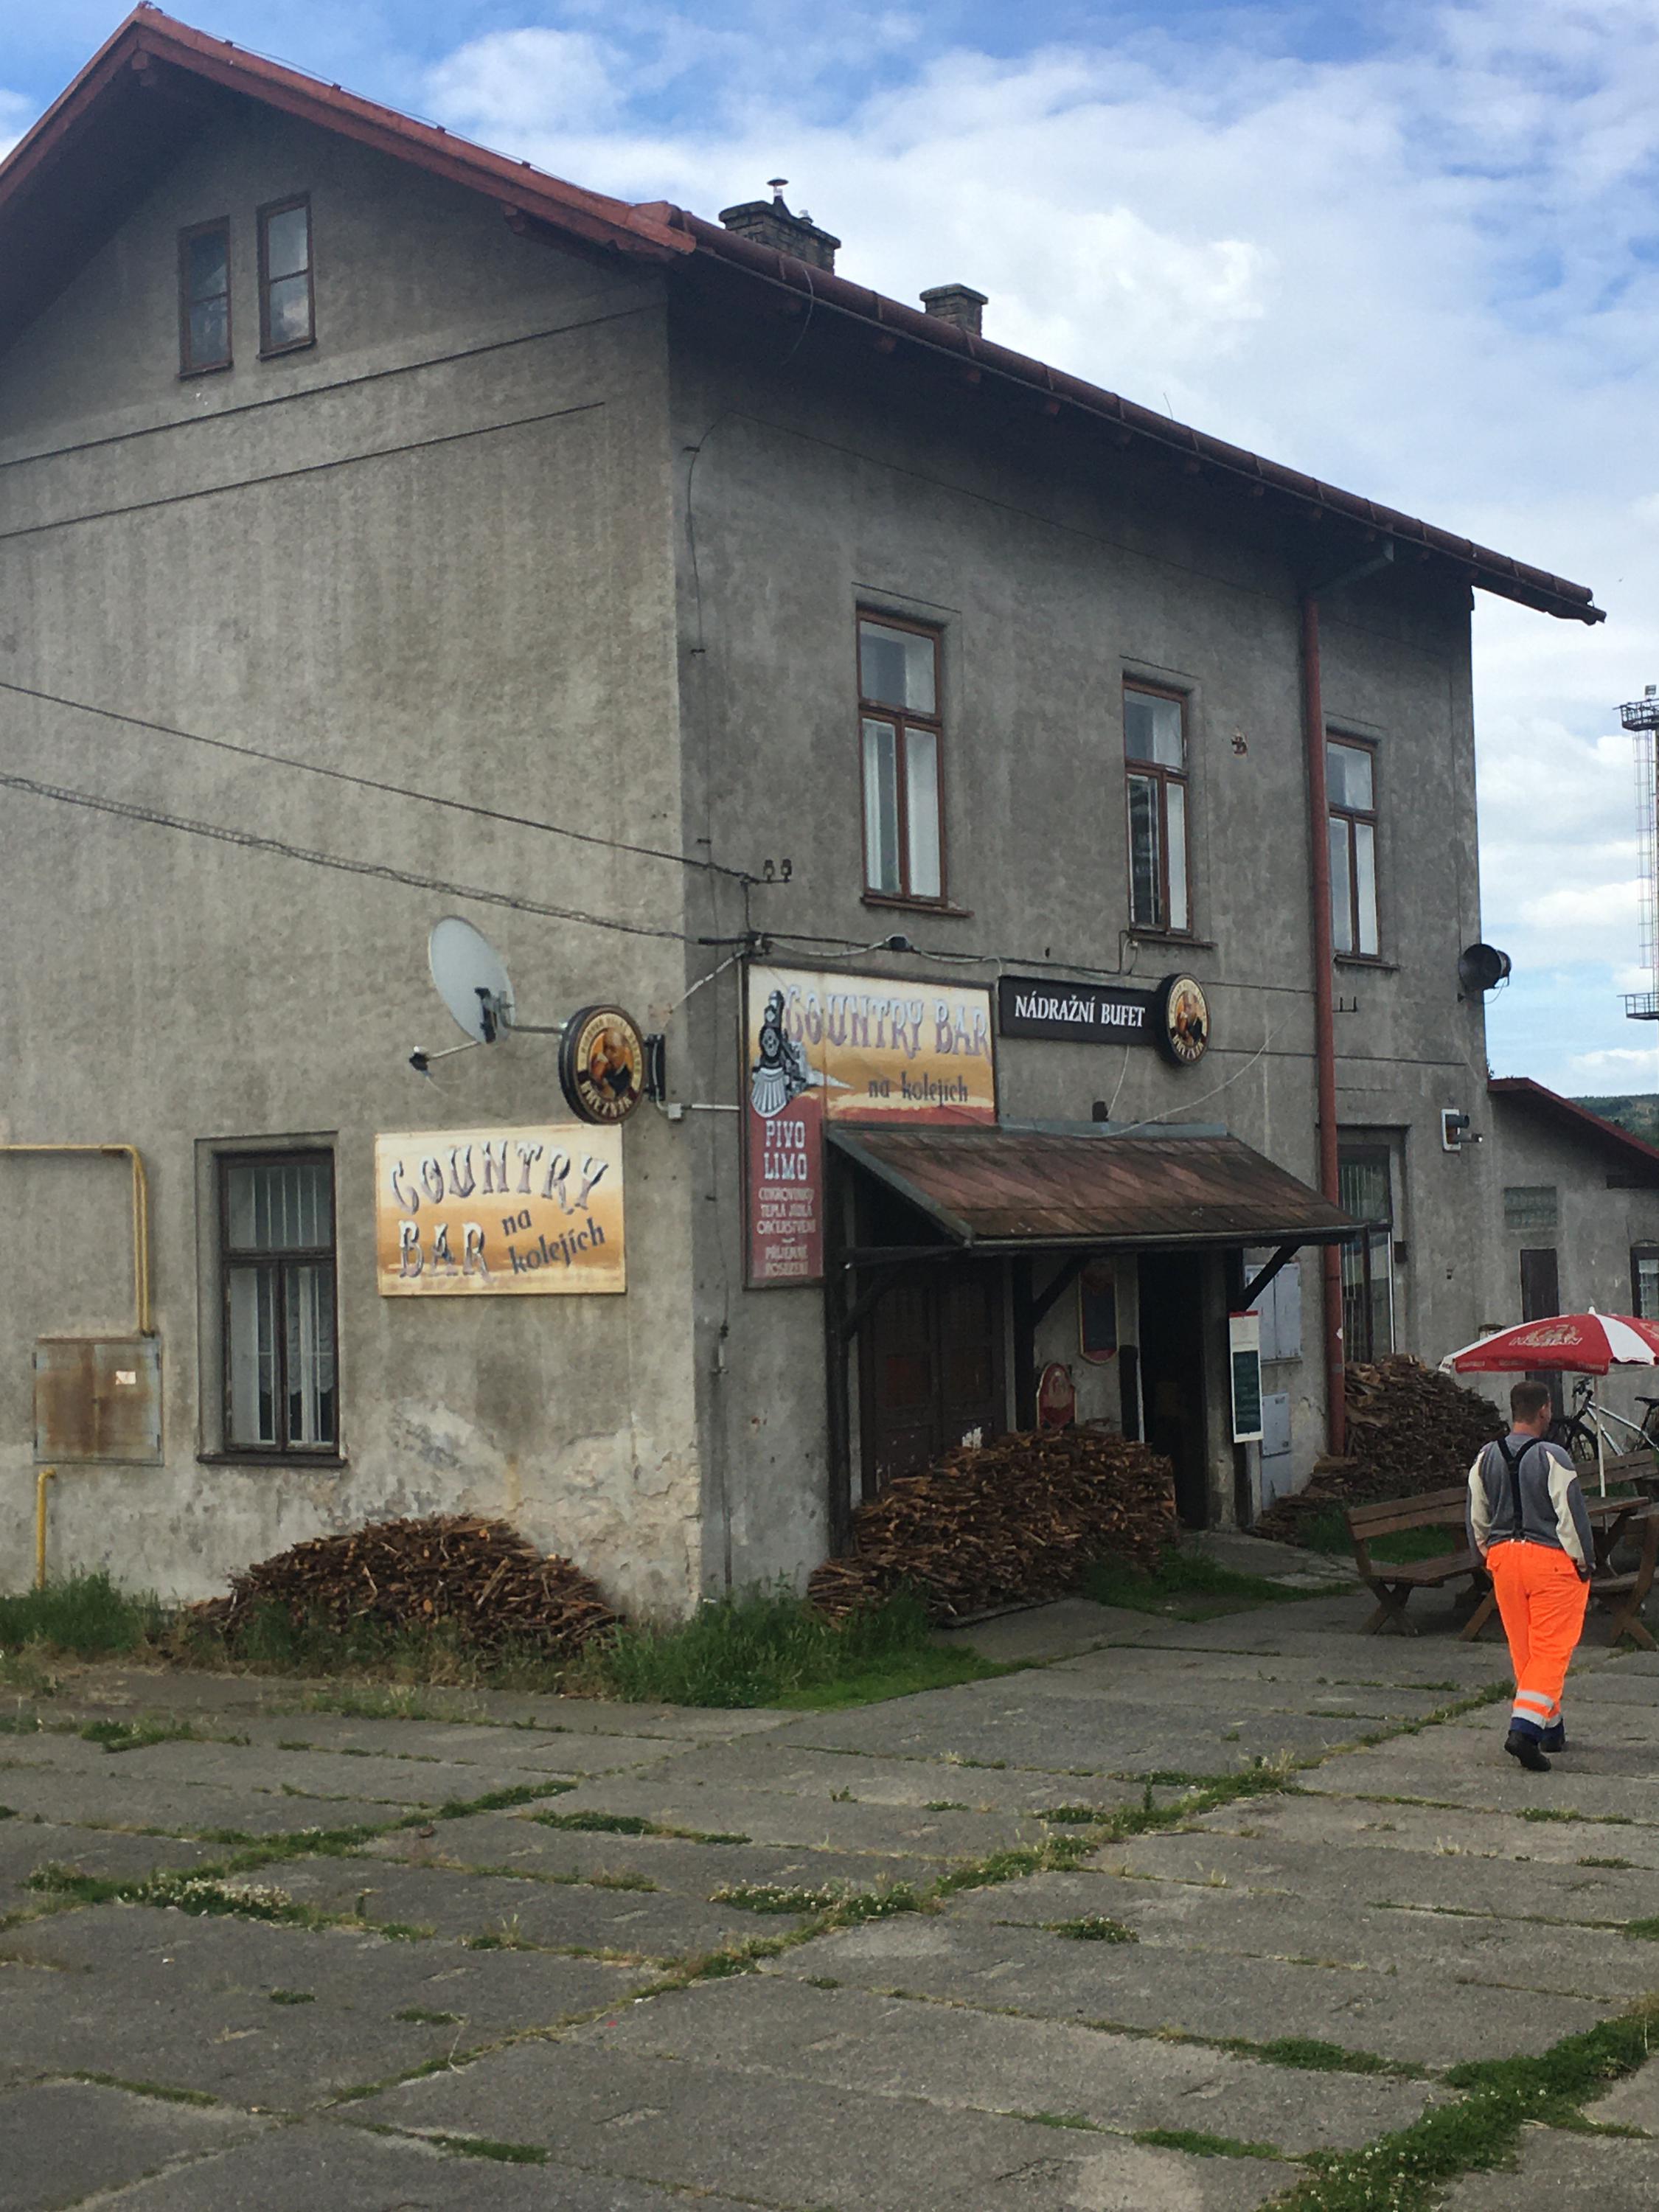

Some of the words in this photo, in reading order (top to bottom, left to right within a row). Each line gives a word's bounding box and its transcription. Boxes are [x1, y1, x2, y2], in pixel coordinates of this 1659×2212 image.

[785, 984, 923, 1060] COUNTRY
[933, 998, 992, 1062] BAR
[1015, 991, 1096, 1023] NÁDRAŽNÍ
[1101, 1004, 1145, 1027] BUFET
[869, 1079, 890, 1099] na
[765, 1120, 805, 1148] PIVO
[390, 1140, 609, 1215] COUNTRY
[764, 1152, 807, 1180] LIMO
[501, 1208, 532, 1237] na
[398, 1220, 495, 1284] BAR
